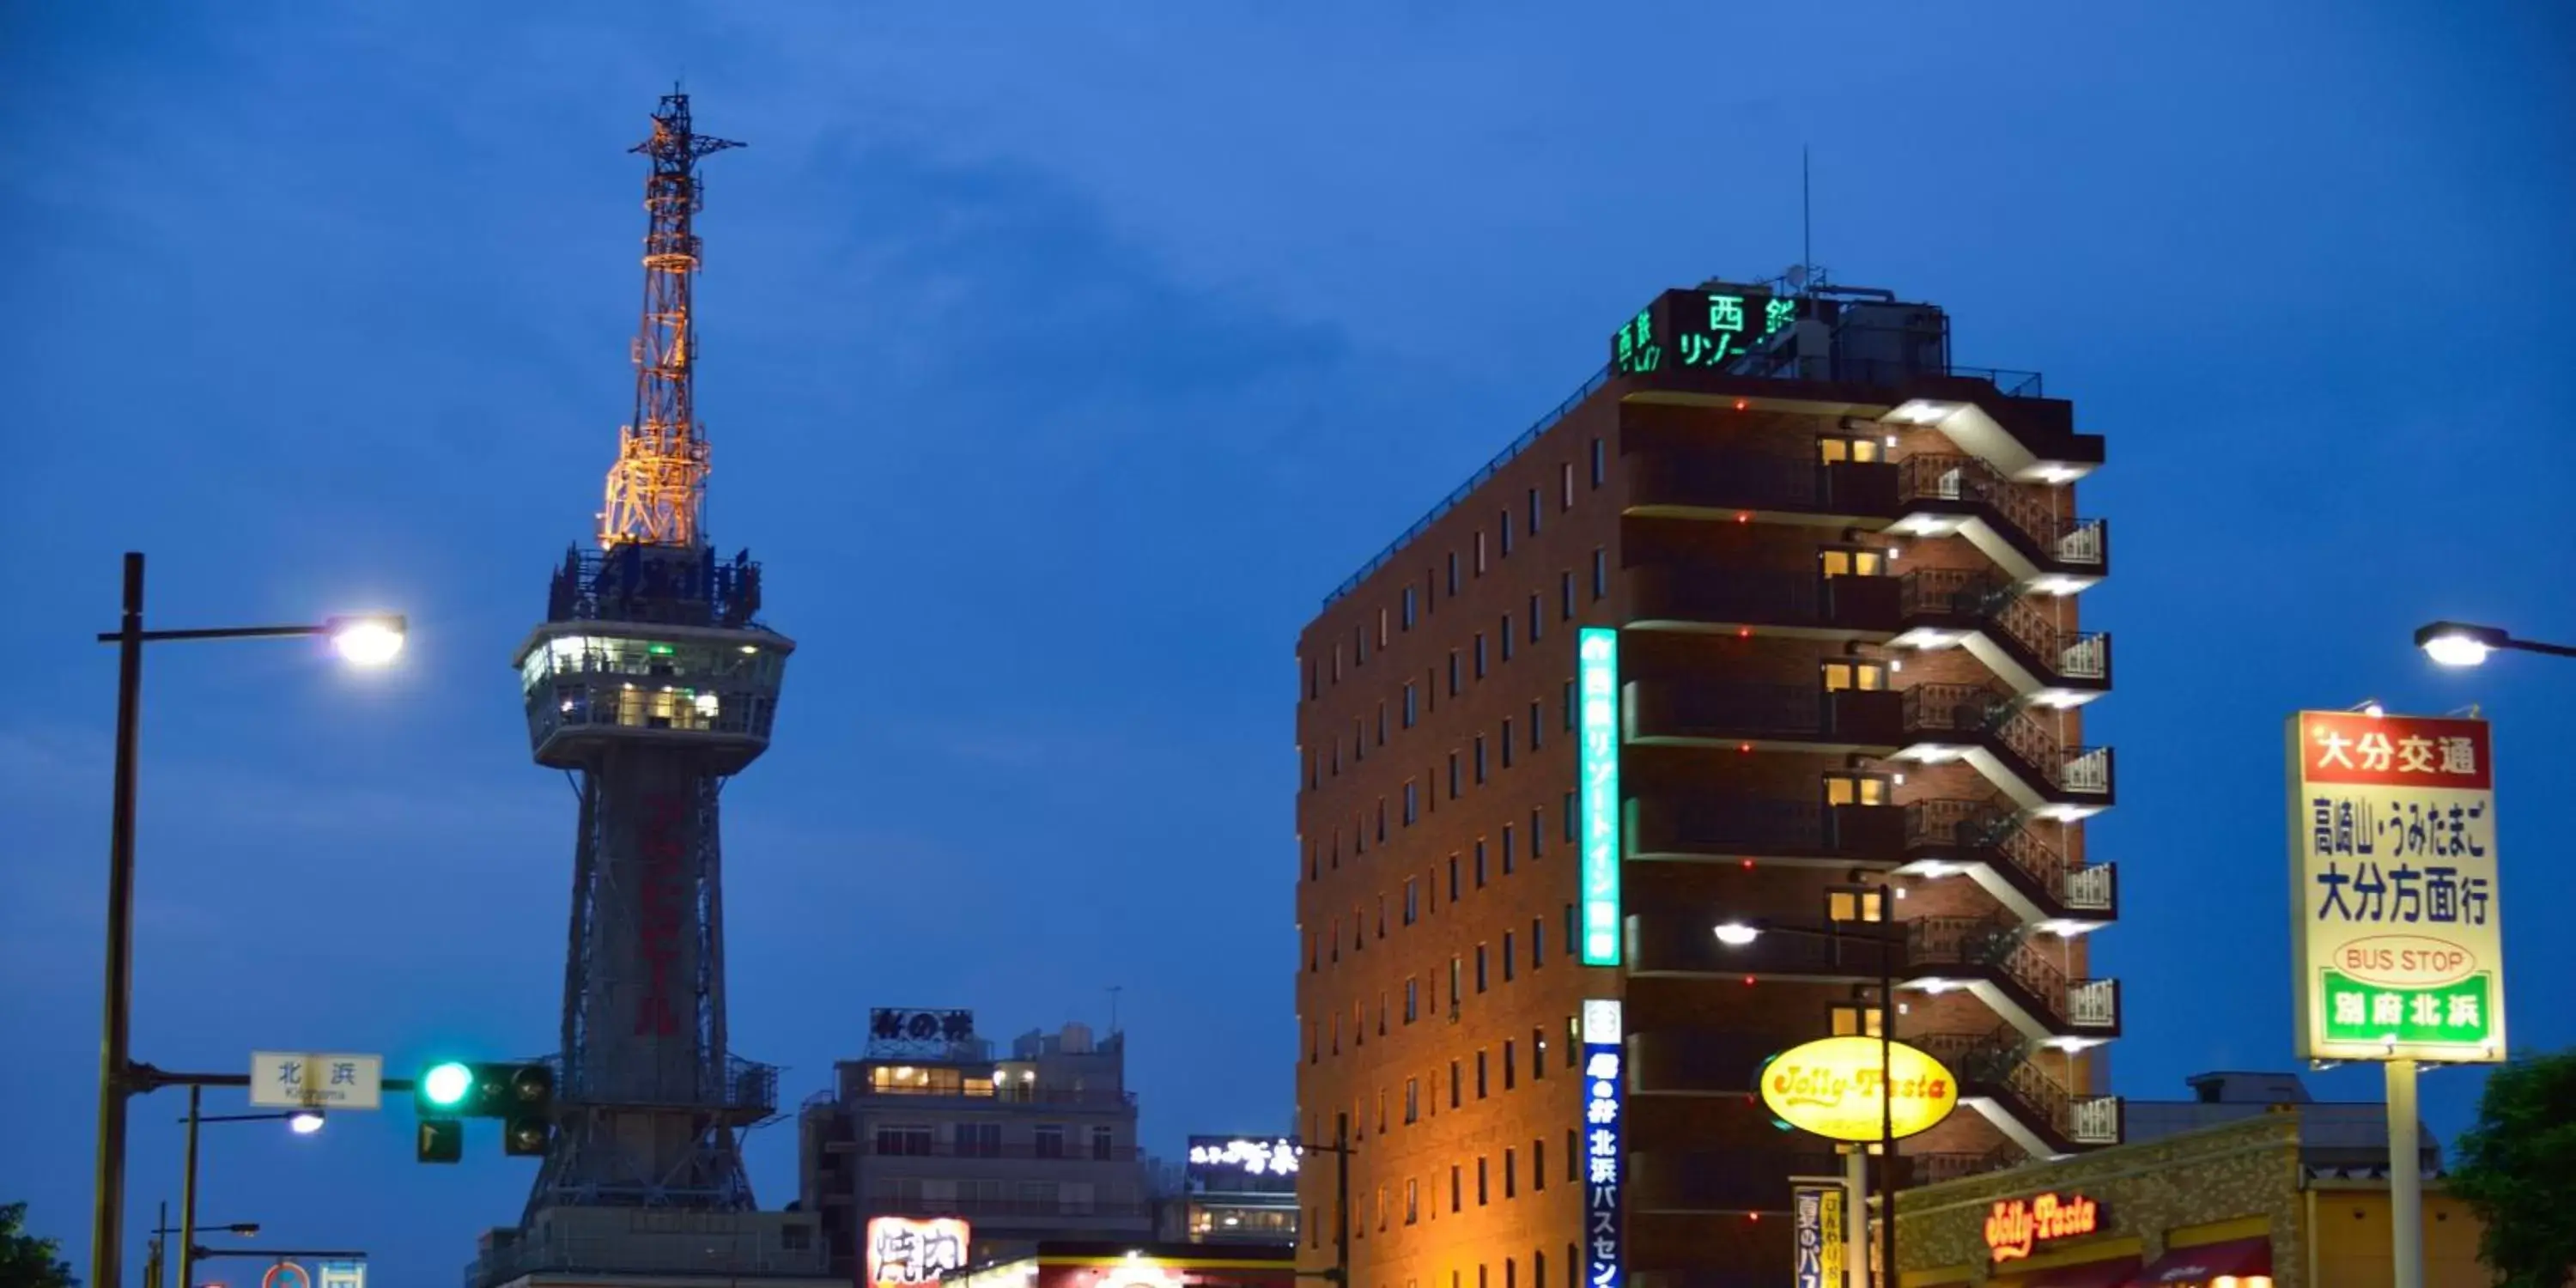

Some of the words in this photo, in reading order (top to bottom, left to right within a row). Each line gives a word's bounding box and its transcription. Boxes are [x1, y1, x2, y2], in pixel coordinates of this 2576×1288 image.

[2317, 730, 2477, 775] 大分交通
[2313, 796, 2485, 859] 高崎山・うみたまご
[2316, 861, 2488, 926] 大分方面行
[2347, 948, 2394, 970] BUS
[2401, 950, 2464, 972] STOP
[2334, 991, 2481, 1028] 別府北浜
[277, 1060, 357, 1086] 北浜
[1773, 1066, 1947, 1108] Jolly-Psta
[1984, 1192, 2096, 1263] Jolly-Pasta
[876, 1227, 960, 1281] 焼肉
